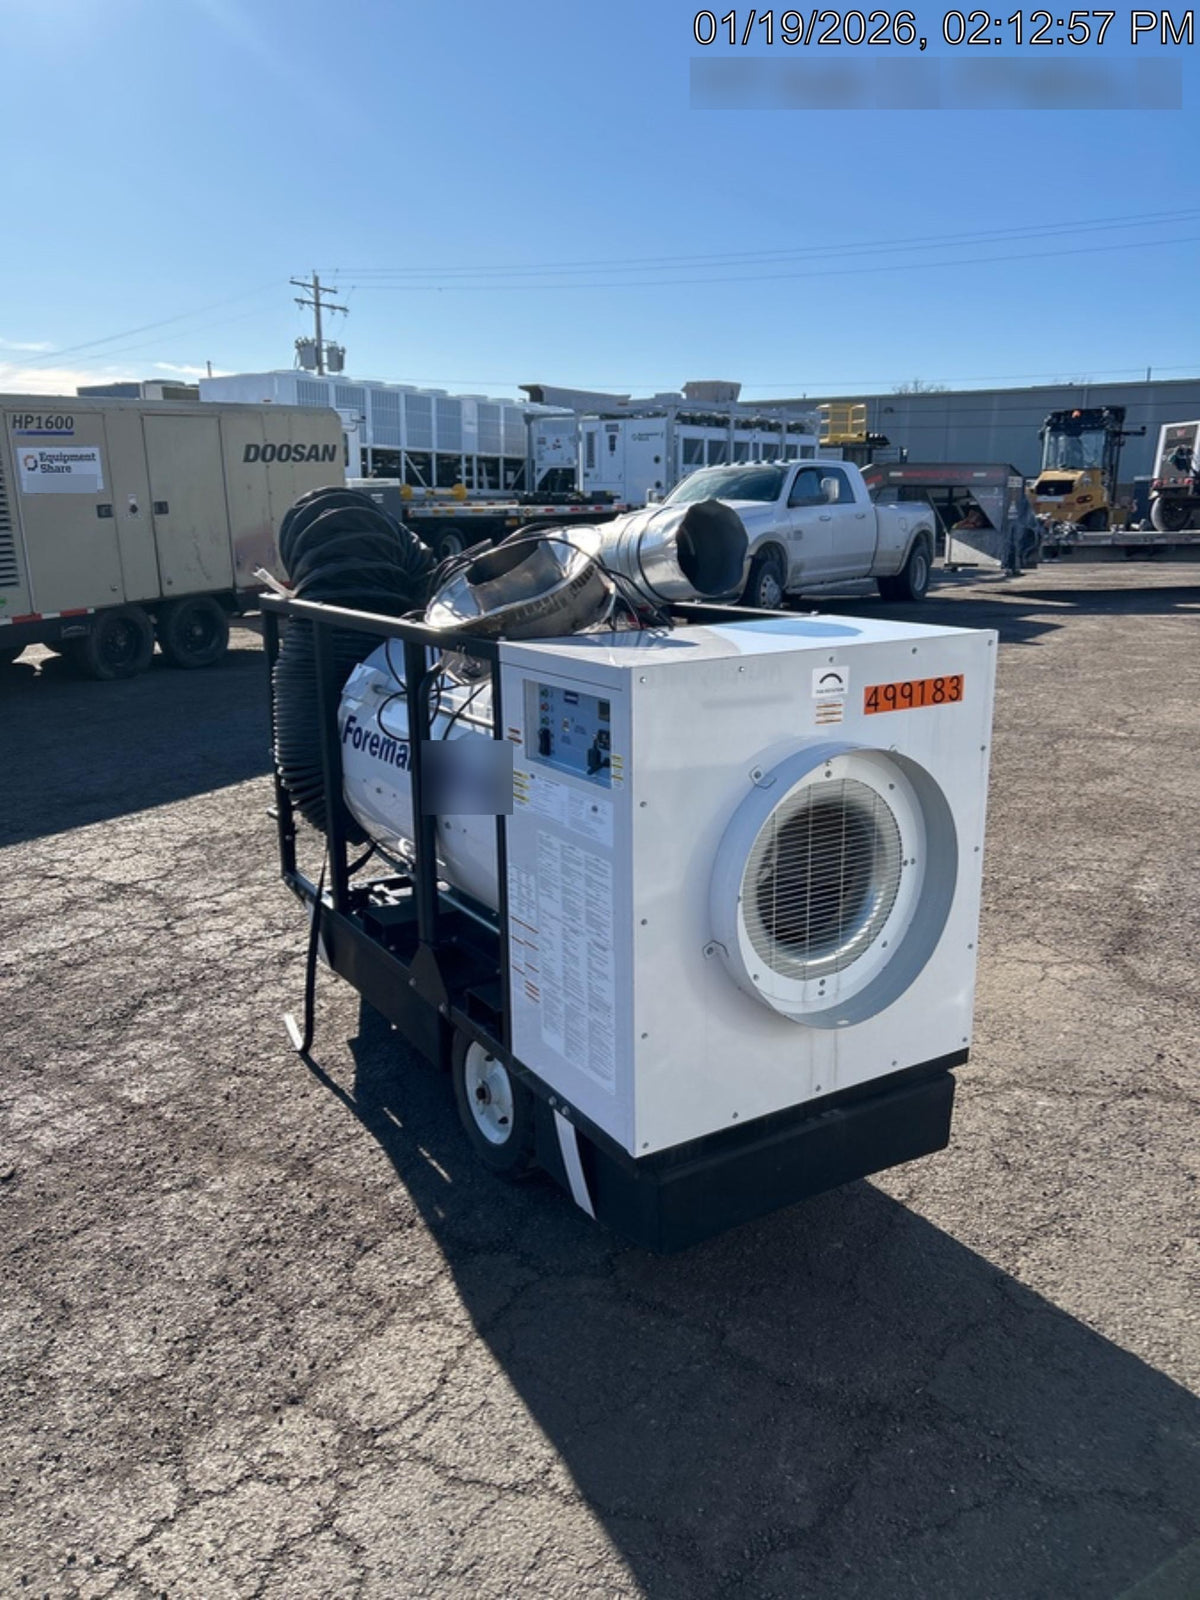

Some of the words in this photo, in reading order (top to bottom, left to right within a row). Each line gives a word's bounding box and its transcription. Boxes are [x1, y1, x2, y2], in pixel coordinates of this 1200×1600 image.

[12, 414, 74, 430] HP1600
[39, 452, 97, 464] Equipment
[243, 443, 337, 463] DOOSAN
[40, 463, 72, 474] Share
[865, 675, 962, 713] 499183
[342, 714, 412, 772] Forema
